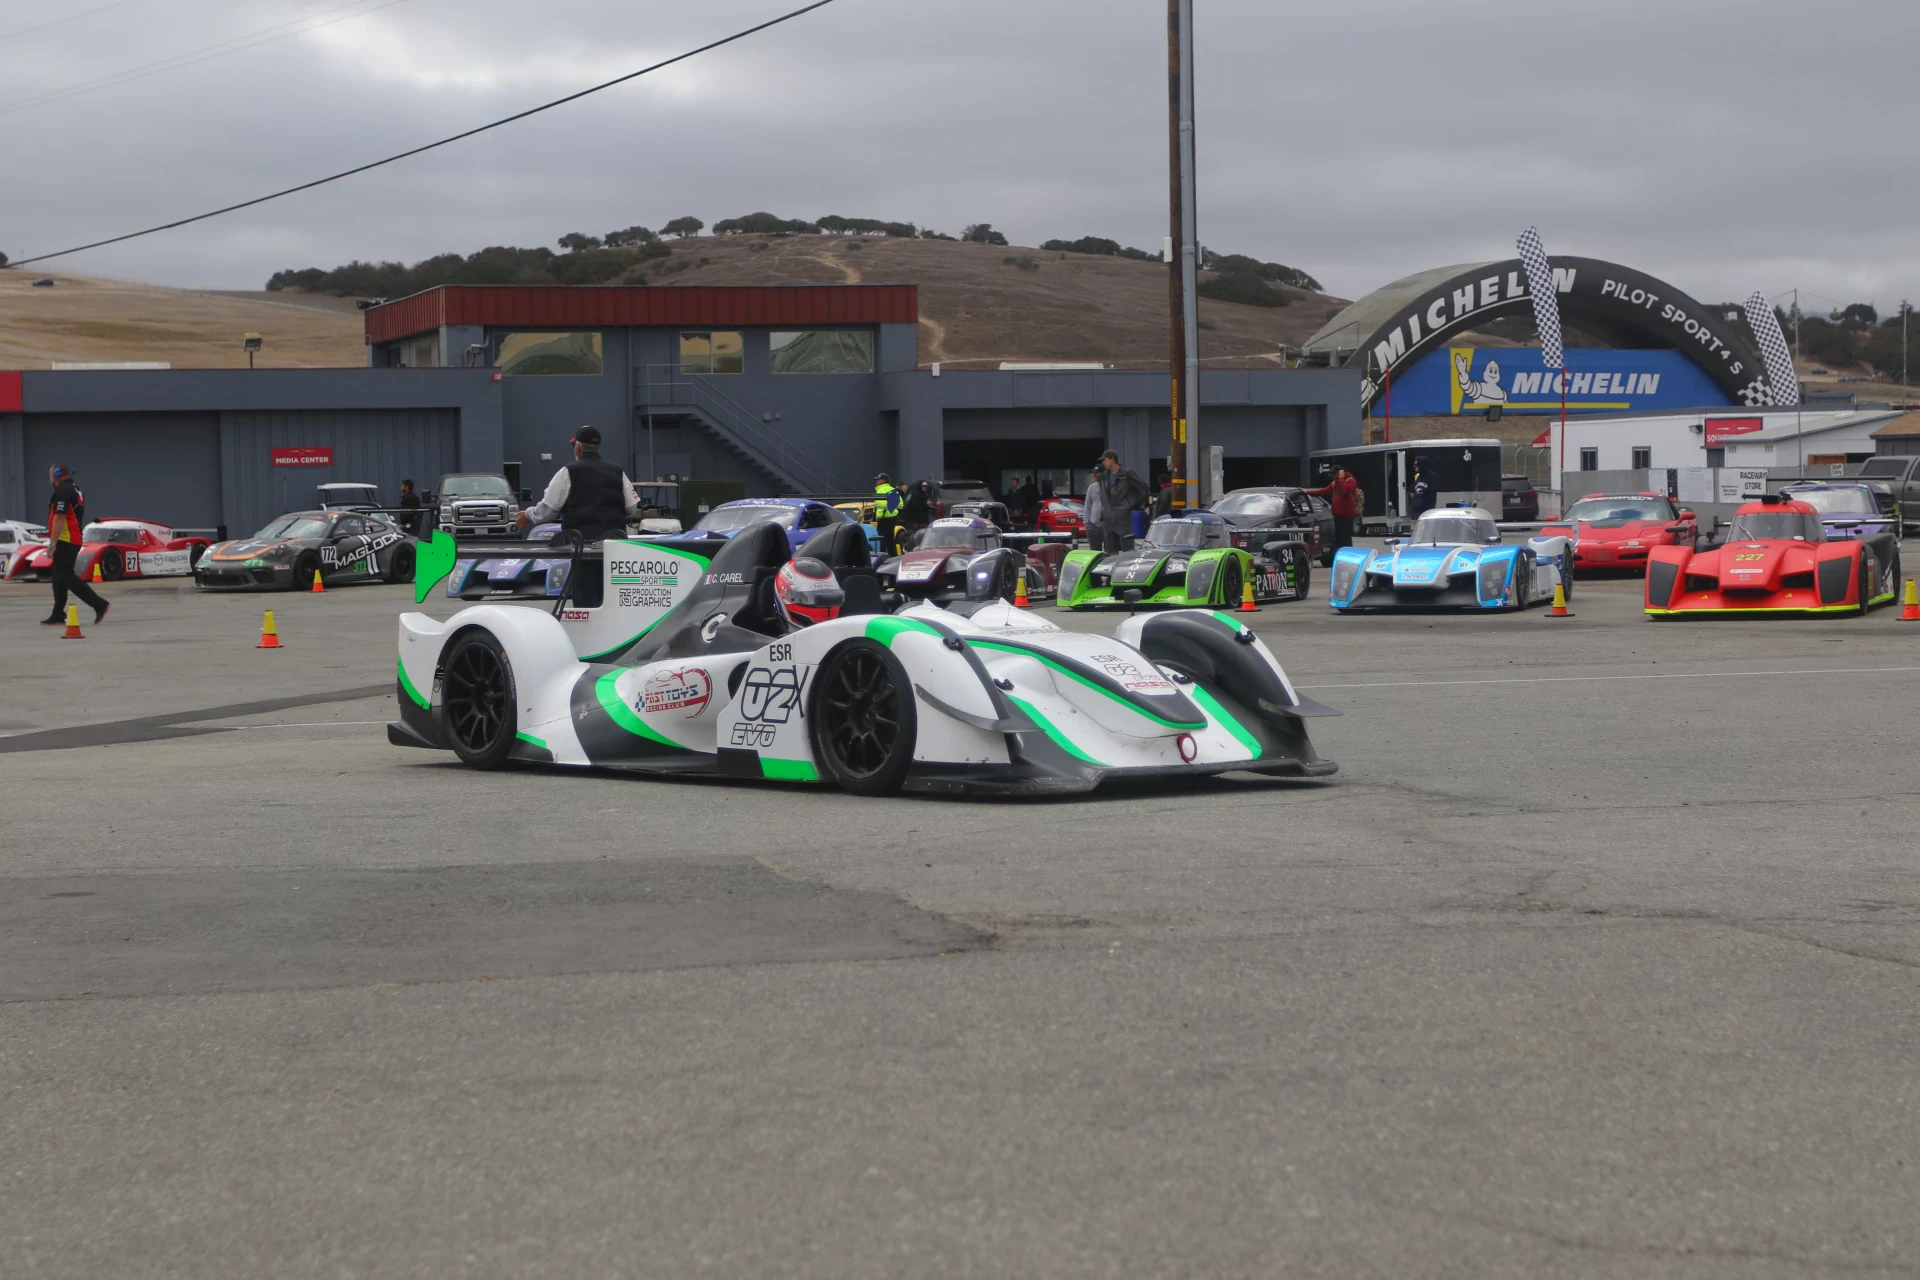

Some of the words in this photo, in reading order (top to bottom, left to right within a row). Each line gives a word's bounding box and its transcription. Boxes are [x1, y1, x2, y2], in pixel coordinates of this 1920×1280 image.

[1373, 267, 1577, 373] MICHELN
[1601, 279, 1658, 310] PILOT
[1661, 303, 1722, 352] SPORT
[1720, 350, 1732, 361] 4
[1729, 360, 1744, 376] S
[1511, 372, 1661, 395] MICHELIN
[1739, 471, 1768, 480] RACEWAY
[1745, 481, 1762, 490] STORE
[334, 531, 404, 570] MAGLOCK
[1282, 549, 1293, 563] 34
[1735, 553, 1766, 561] 227
[127, 557, 137, 570] 27
[242, 559, 264, 567] ST1
[611, 560, 679, 575] PESCAROLO
[1167, 563, 1185, 571] 34
[640, 576, 662, 585] SPORT
[719, 573, 743, 583] CAREL
[1256, 571, 1288, 591] PATRON
[632, 588, 672, 597] PRODUCTION
[632, 597, 672, 607] GRAPHICS
[769, 644, 792, 662] ESR
[1089, 654, 1123, 663] ESR
[667, 701, 685, 709] CLUB
[731, 722, 776, 748] EVO
